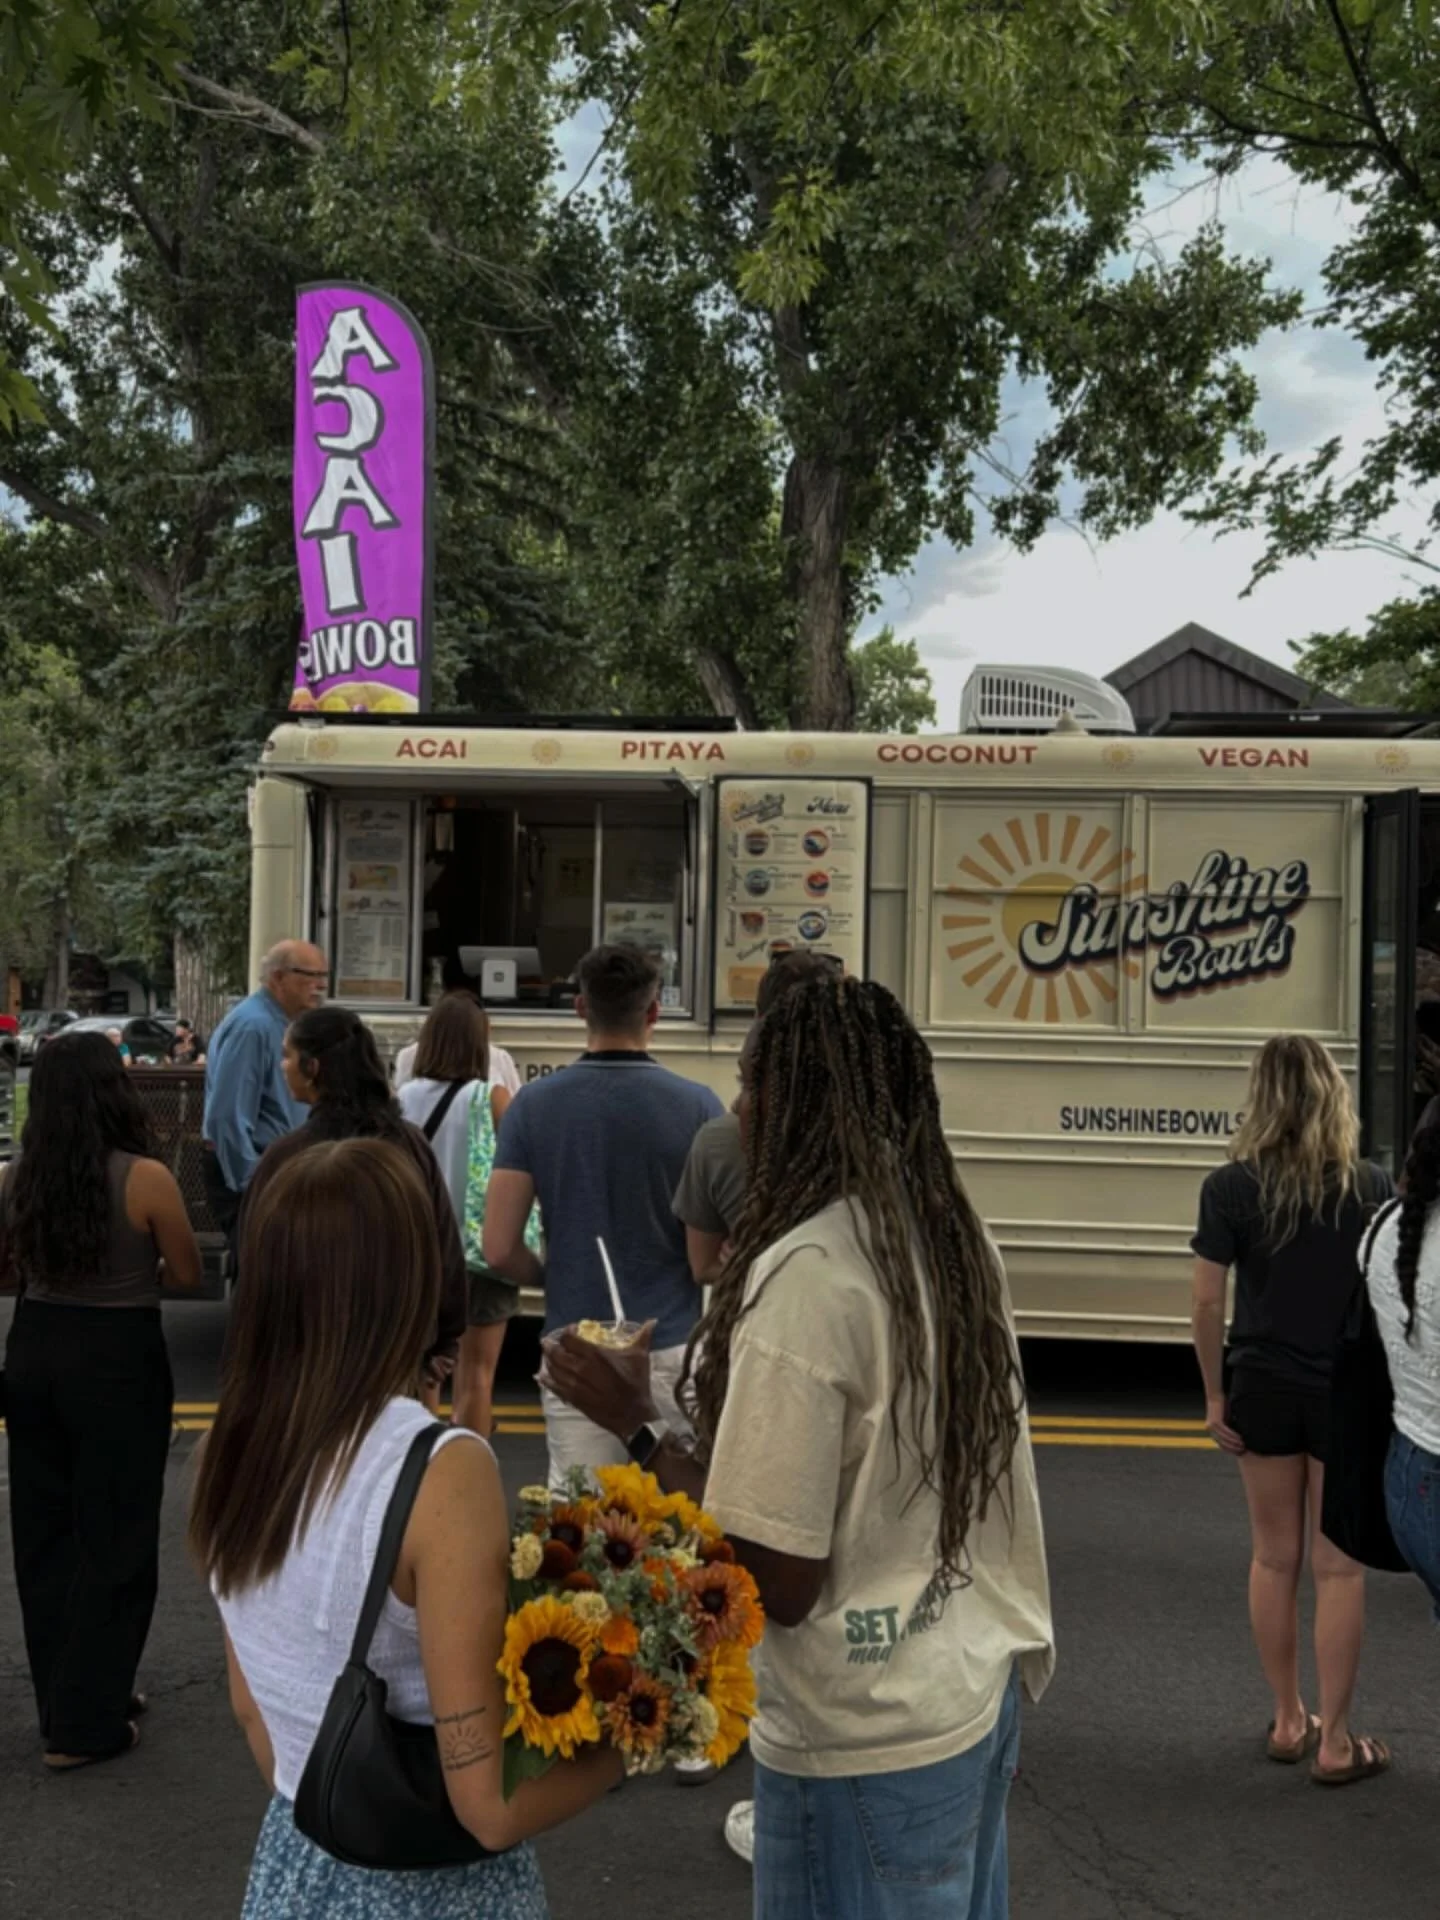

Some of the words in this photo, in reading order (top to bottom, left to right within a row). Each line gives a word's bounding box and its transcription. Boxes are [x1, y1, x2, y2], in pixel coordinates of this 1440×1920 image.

[395, 738, 467, 759] ACAI
[621, 740, 726, 761] PITAYA
[876, 743, 1038, 765] COCONUT
[1198, 747, 1310, 768] VEGAN
[1020, 850, 1310, 975] Sunshine
[1151, 914, 1295, 1001] Bowls
